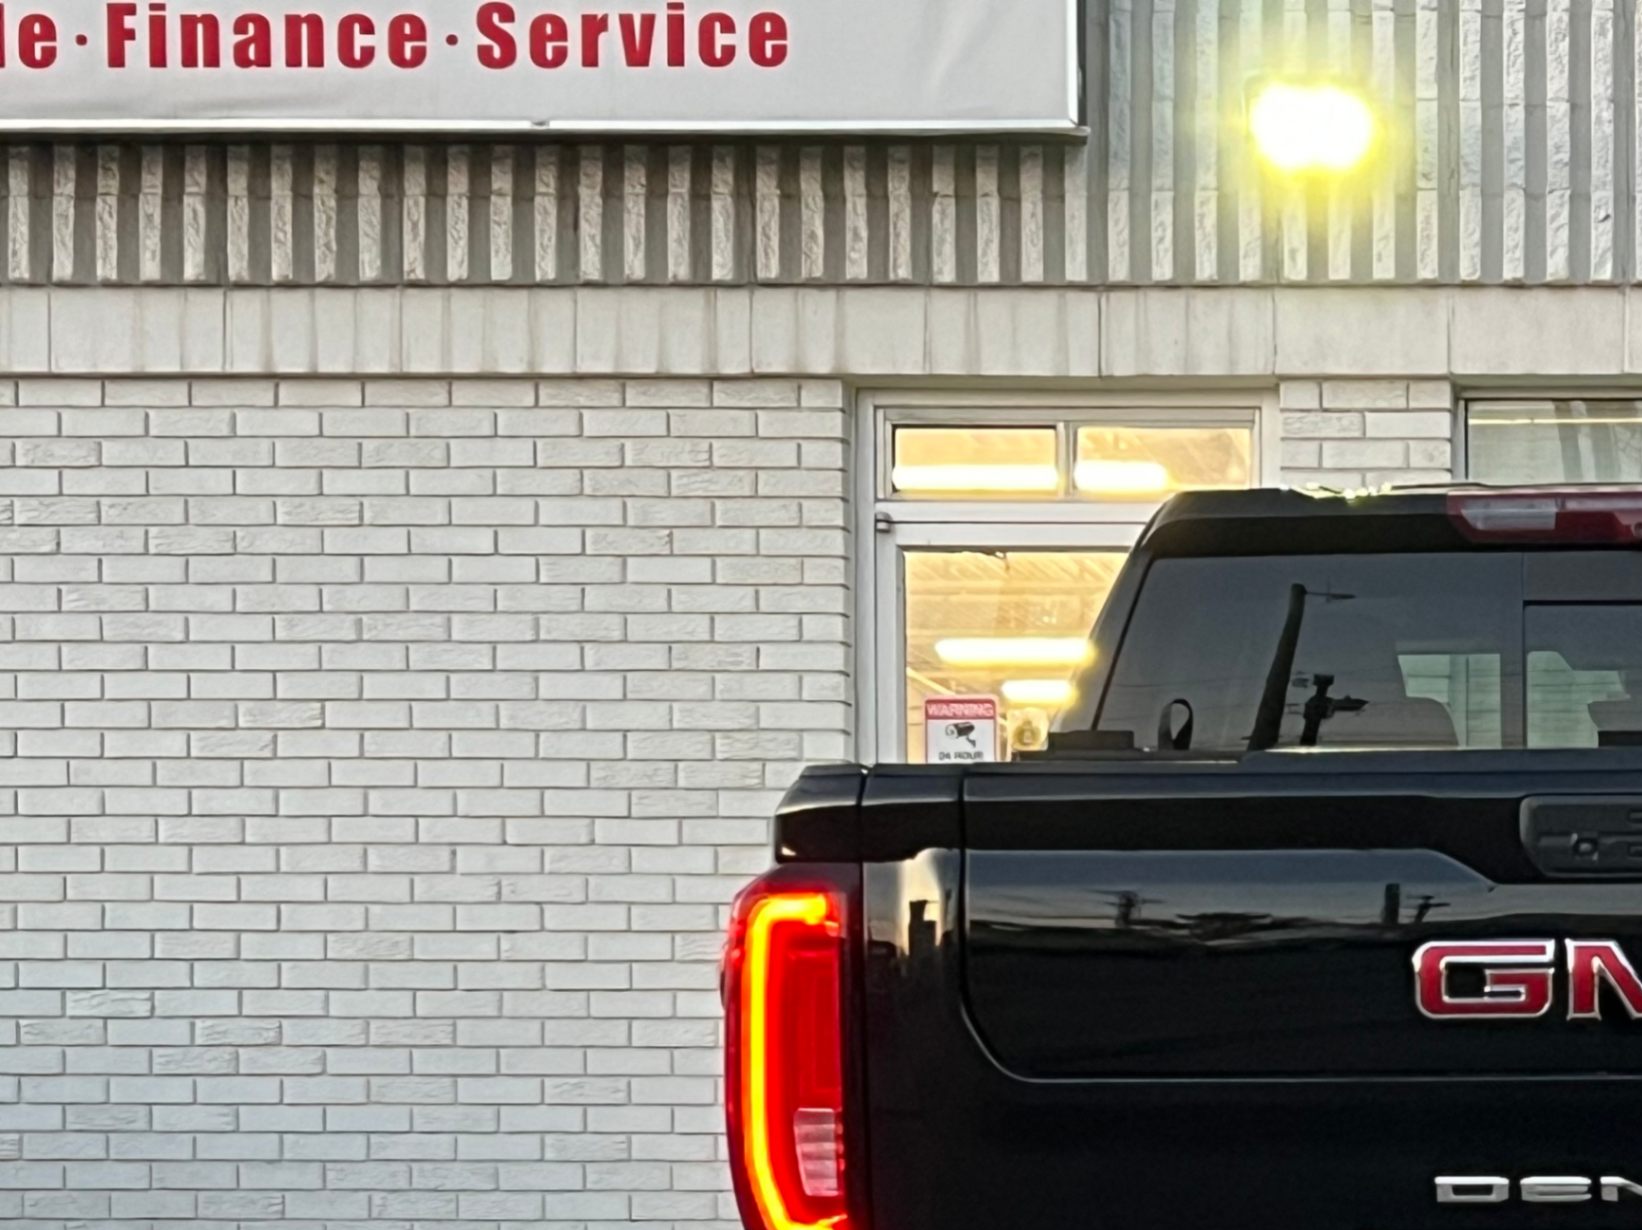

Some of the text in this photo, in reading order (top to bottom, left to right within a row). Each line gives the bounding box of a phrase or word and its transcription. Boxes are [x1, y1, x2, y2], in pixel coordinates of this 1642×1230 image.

[0, 1, 788, 69] e Finance Service
[926, 702, 994, 716] WARNING
